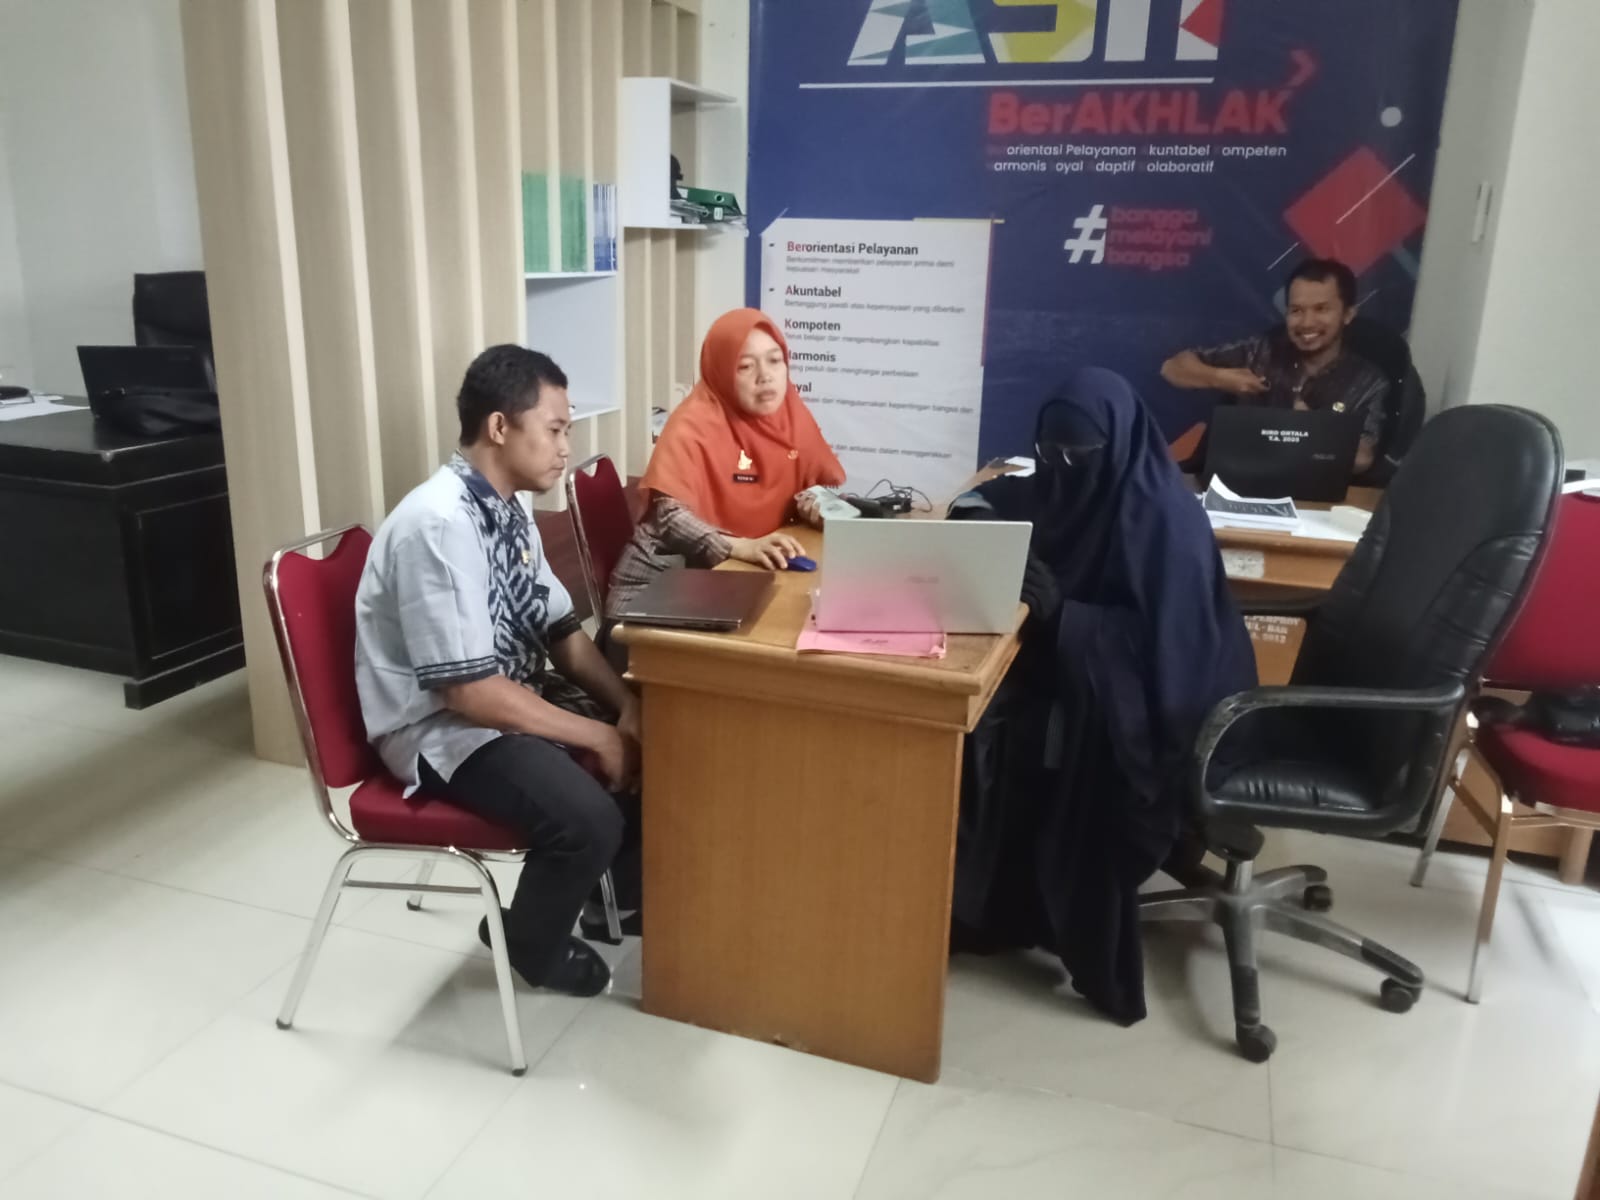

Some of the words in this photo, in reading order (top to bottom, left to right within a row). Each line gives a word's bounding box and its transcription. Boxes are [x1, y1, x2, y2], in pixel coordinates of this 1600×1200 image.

[988, 89, 1292, 136] BerAKHLAK
[1066, 144, 1136, 158] Pelayanan
[787, 240, 856, 254] Berorientasi
[858, 243, 919, 257] Pelayanan
[785, 285, 842, 297] Akuntabel
